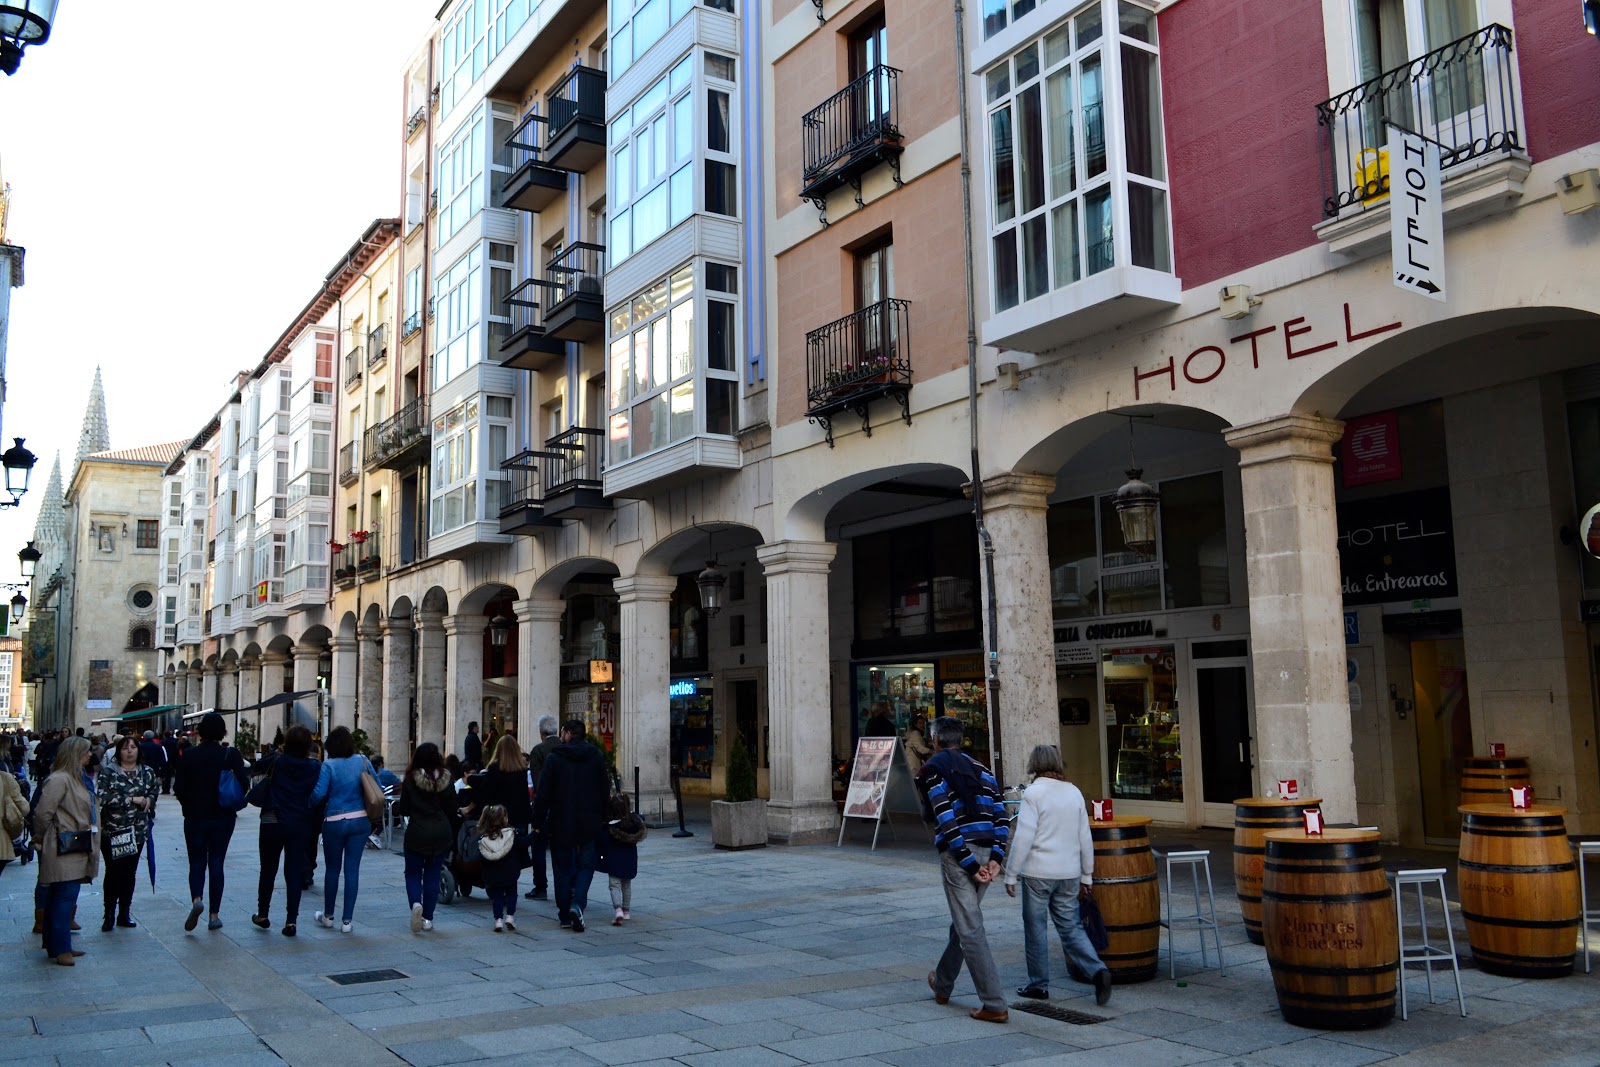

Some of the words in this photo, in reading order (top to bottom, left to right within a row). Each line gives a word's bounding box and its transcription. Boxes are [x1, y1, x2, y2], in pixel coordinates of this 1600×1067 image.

[1403, 138, 1430, 271] HOTEL
[1134, 302, 1402, 400] HOTEL
[1338, 519, 1446, 546] HOTEL
[1365, 571, 1448, 592] Entrearcos
[1086, 619, 1154, 640] CONFITERIA
